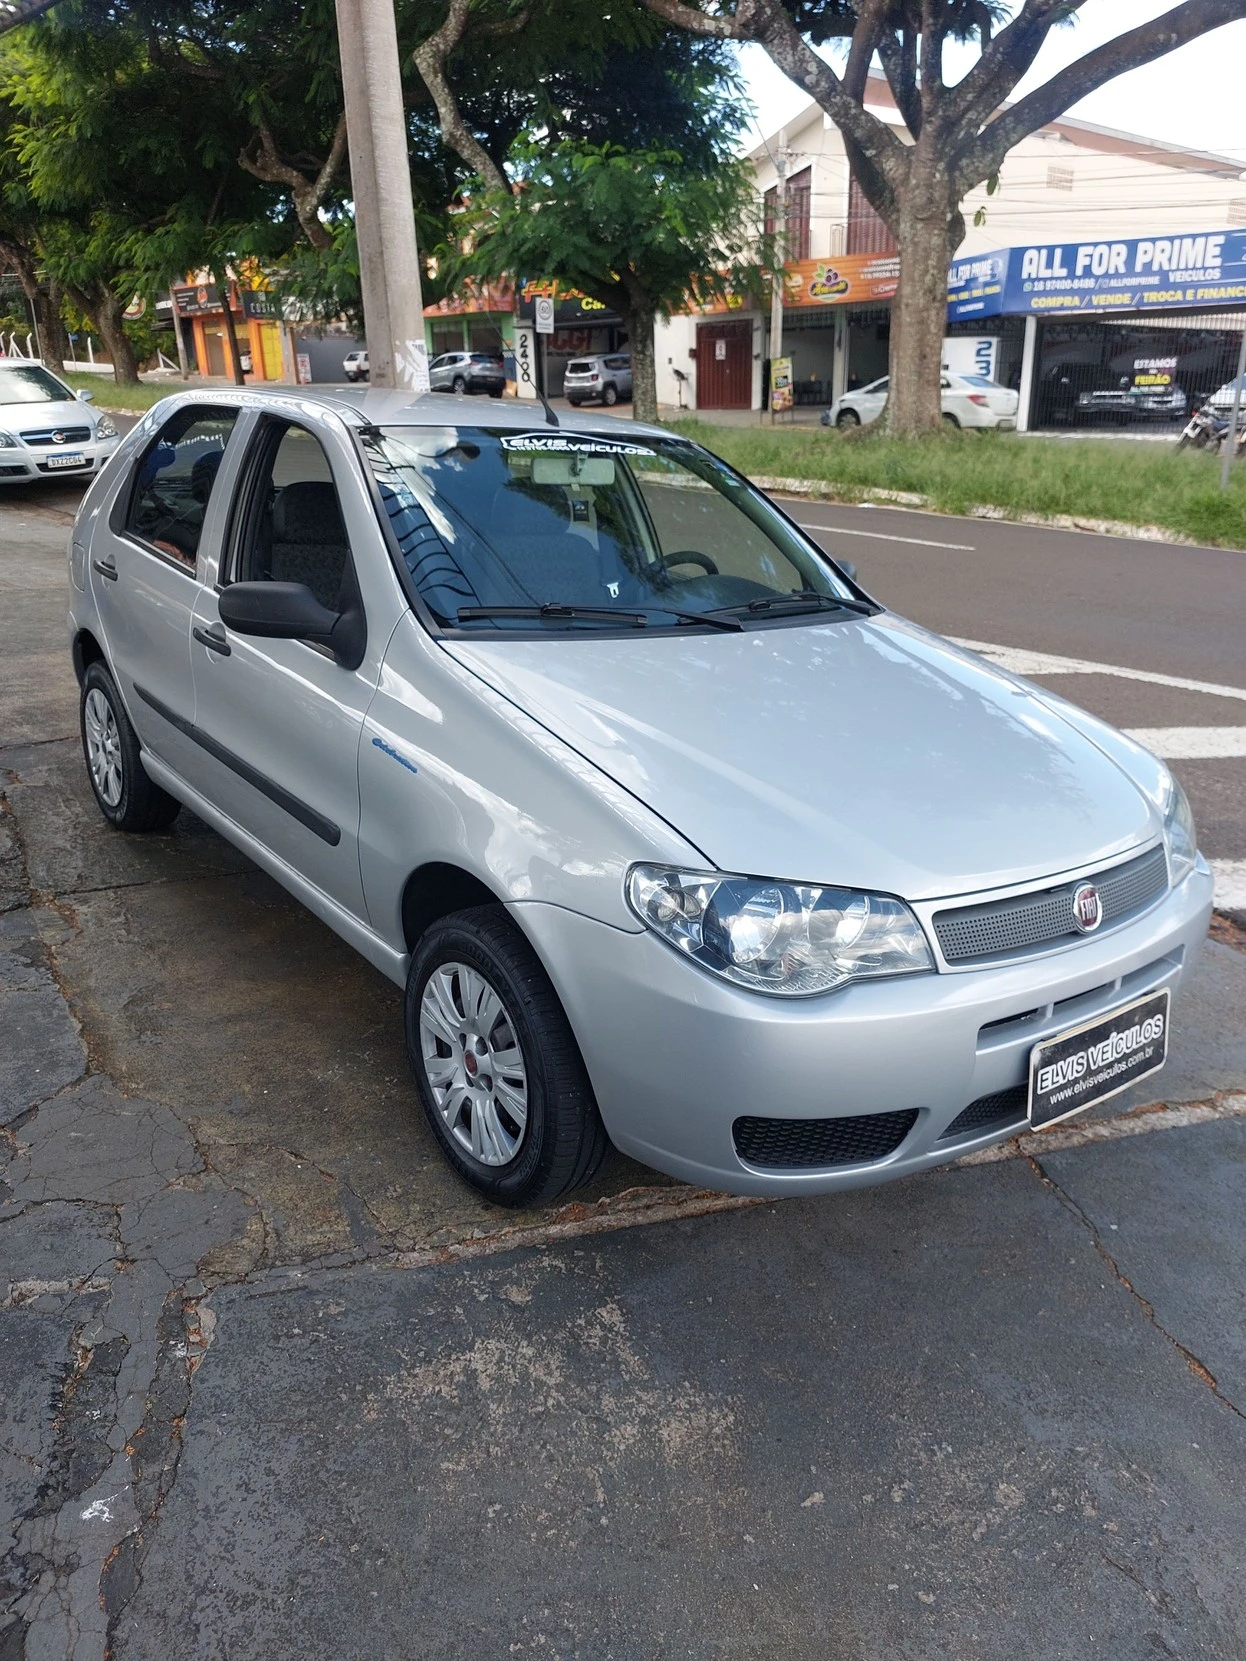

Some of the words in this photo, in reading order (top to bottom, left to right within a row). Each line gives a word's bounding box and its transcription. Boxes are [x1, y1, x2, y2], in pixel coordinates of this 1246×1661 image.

[1021, 248, 1068, 279] ALL
[1075, 244, 1128, 276] FOR
[1134, 235, 1225, 273] PRIME
[1030, 296, 1081, 309] COMPRA
[1091, 292, 1132, 306] VENDE
[1143, 290, 1184, 303] TROCA
[1185, 289, 1195, 301] E
[1133, 357, 1178, 370] ESTAMOS
[509, 438, 568, 448] ELVIS
[1080, 896, 1097, 921] FIAT
[1037, 1051, 1088, 1095] ELVIS
[1087, 1014, 1164, 1070] VEÍCULOS
[1050, 1046, 1154, 1104] www.elvisveiculos.com.br
